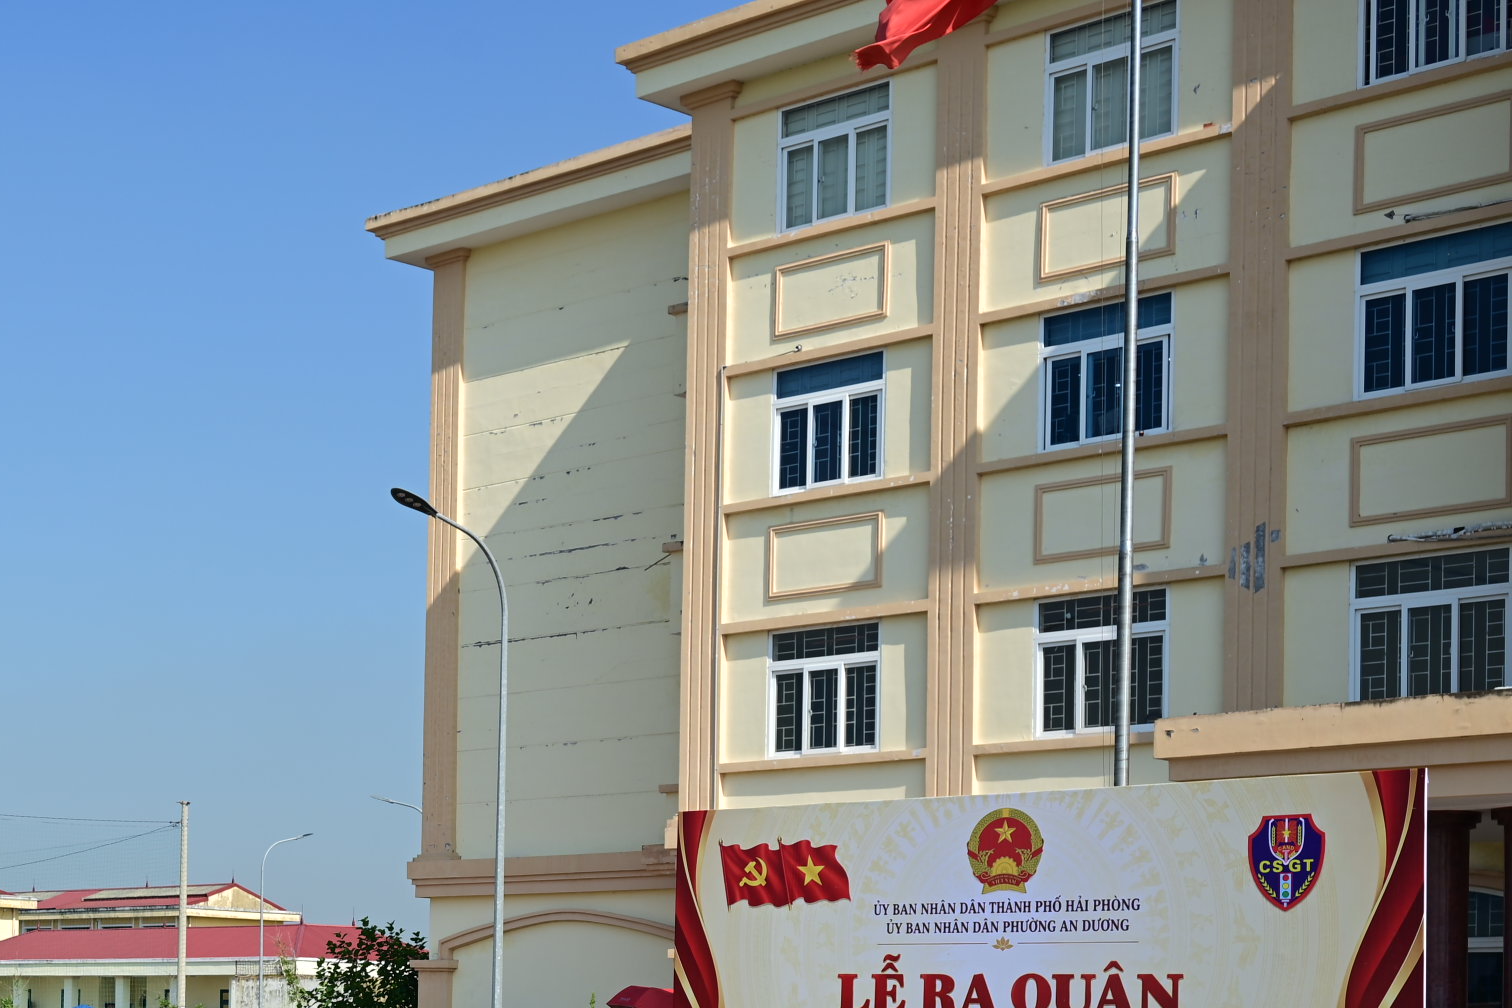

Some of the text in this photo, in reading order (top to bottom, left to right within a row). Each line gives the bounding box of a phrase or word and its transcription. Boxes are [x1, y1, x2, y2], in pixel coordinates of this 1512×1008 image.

[1259, 859, 1314, 873] CSGT
[874, 895, 1141, 916] ỦY BAN NHÂN DÂN THÀNH PHỐ HẢI PHÒNG
[886, 916, 1130, 934] ỦY BAN NHÂN DÂN PHƯỜNG AN DƯƠNG
